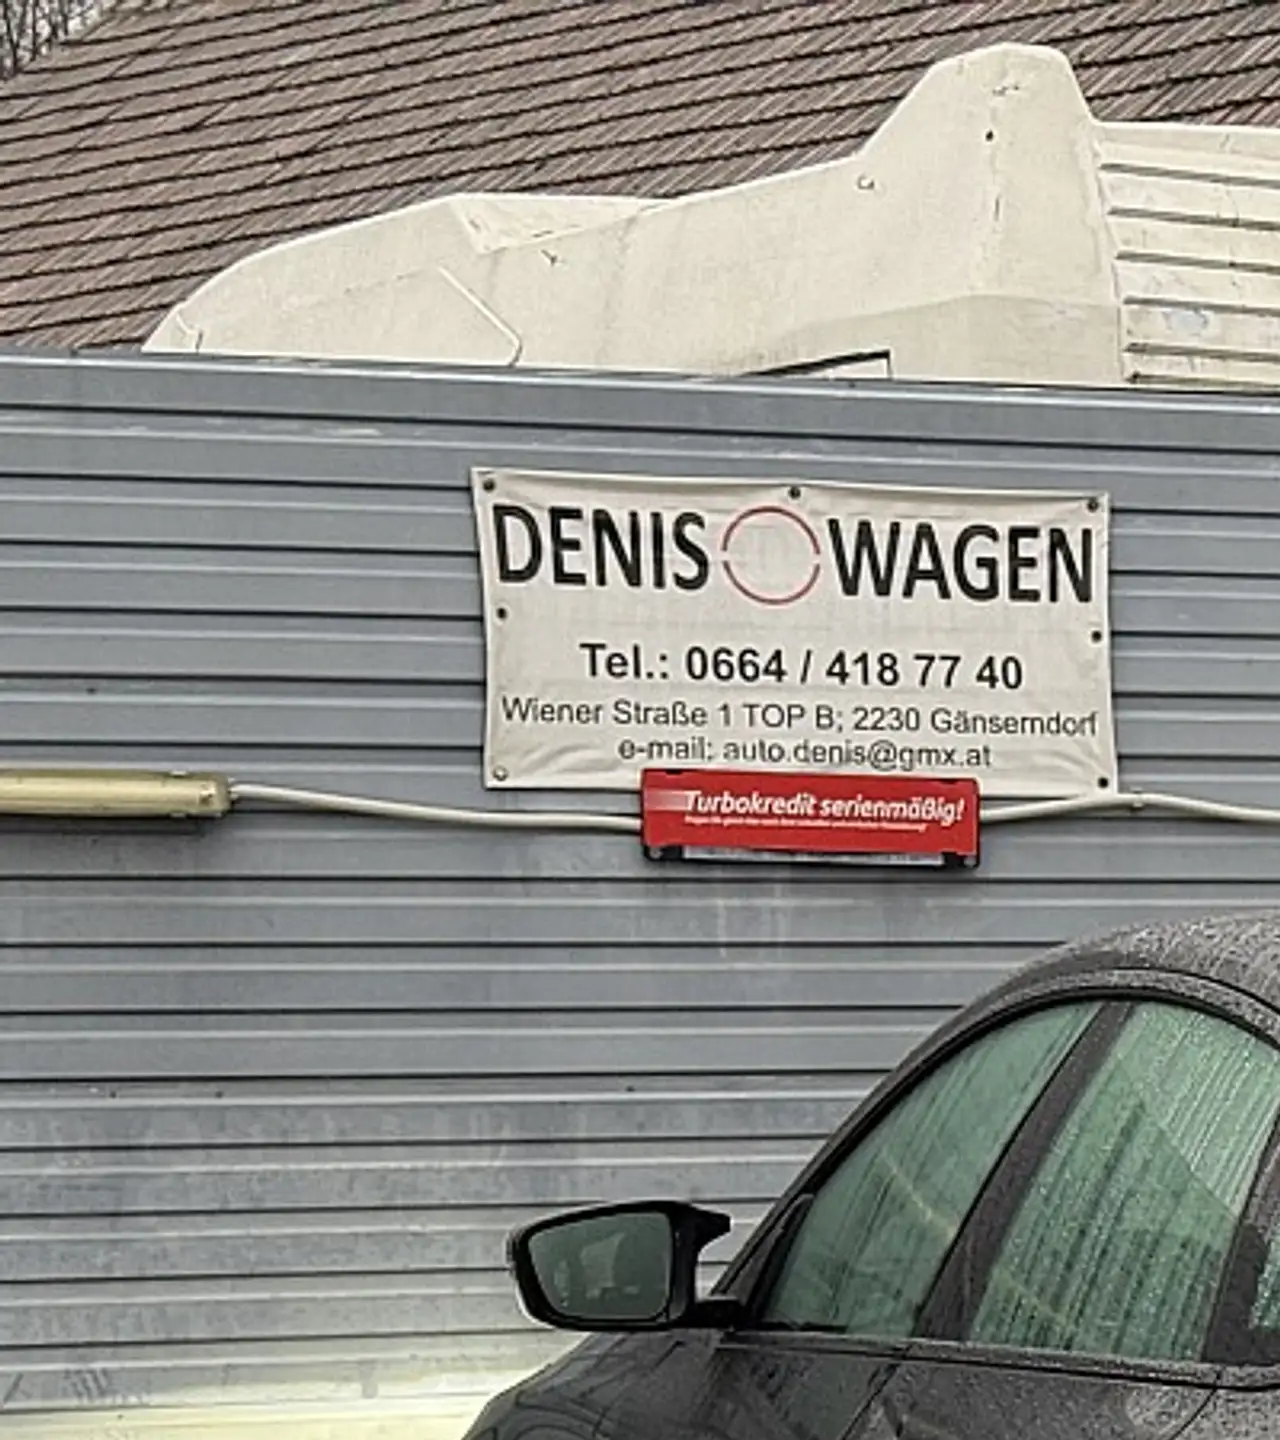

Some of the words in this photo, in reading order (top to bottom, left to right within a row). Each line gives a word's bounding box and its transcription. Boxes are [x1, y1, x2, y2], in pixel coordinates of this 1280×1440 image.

[492, 504, 709, 590] DENIS
[827, 518, 1093, 603] WAGEN
[579, 643, 669, 679] Tel.:
[685, 646, 787, 682] 0664
[799, 649, 812, 685] /
[825, 651, 900, 686] 418
[914, 654, 961, 687] 77
[976, 656, 1023, 689] 40
[502, 696, 602, 722] Wiener
[612, 700, 707, 726] Straße
[718, 704, 732, 726] 1
[742, 704, 806, 728] TOP
[852, 707, 920, 731] 2230
[931, 708, 1098, 736] Gänserndorf
[723, 739, 992, 772] auto.denis@gmx.at
[684, 790, 817, 816] Turbokredit
[819, 794, 965, 827] serienmäßig!
